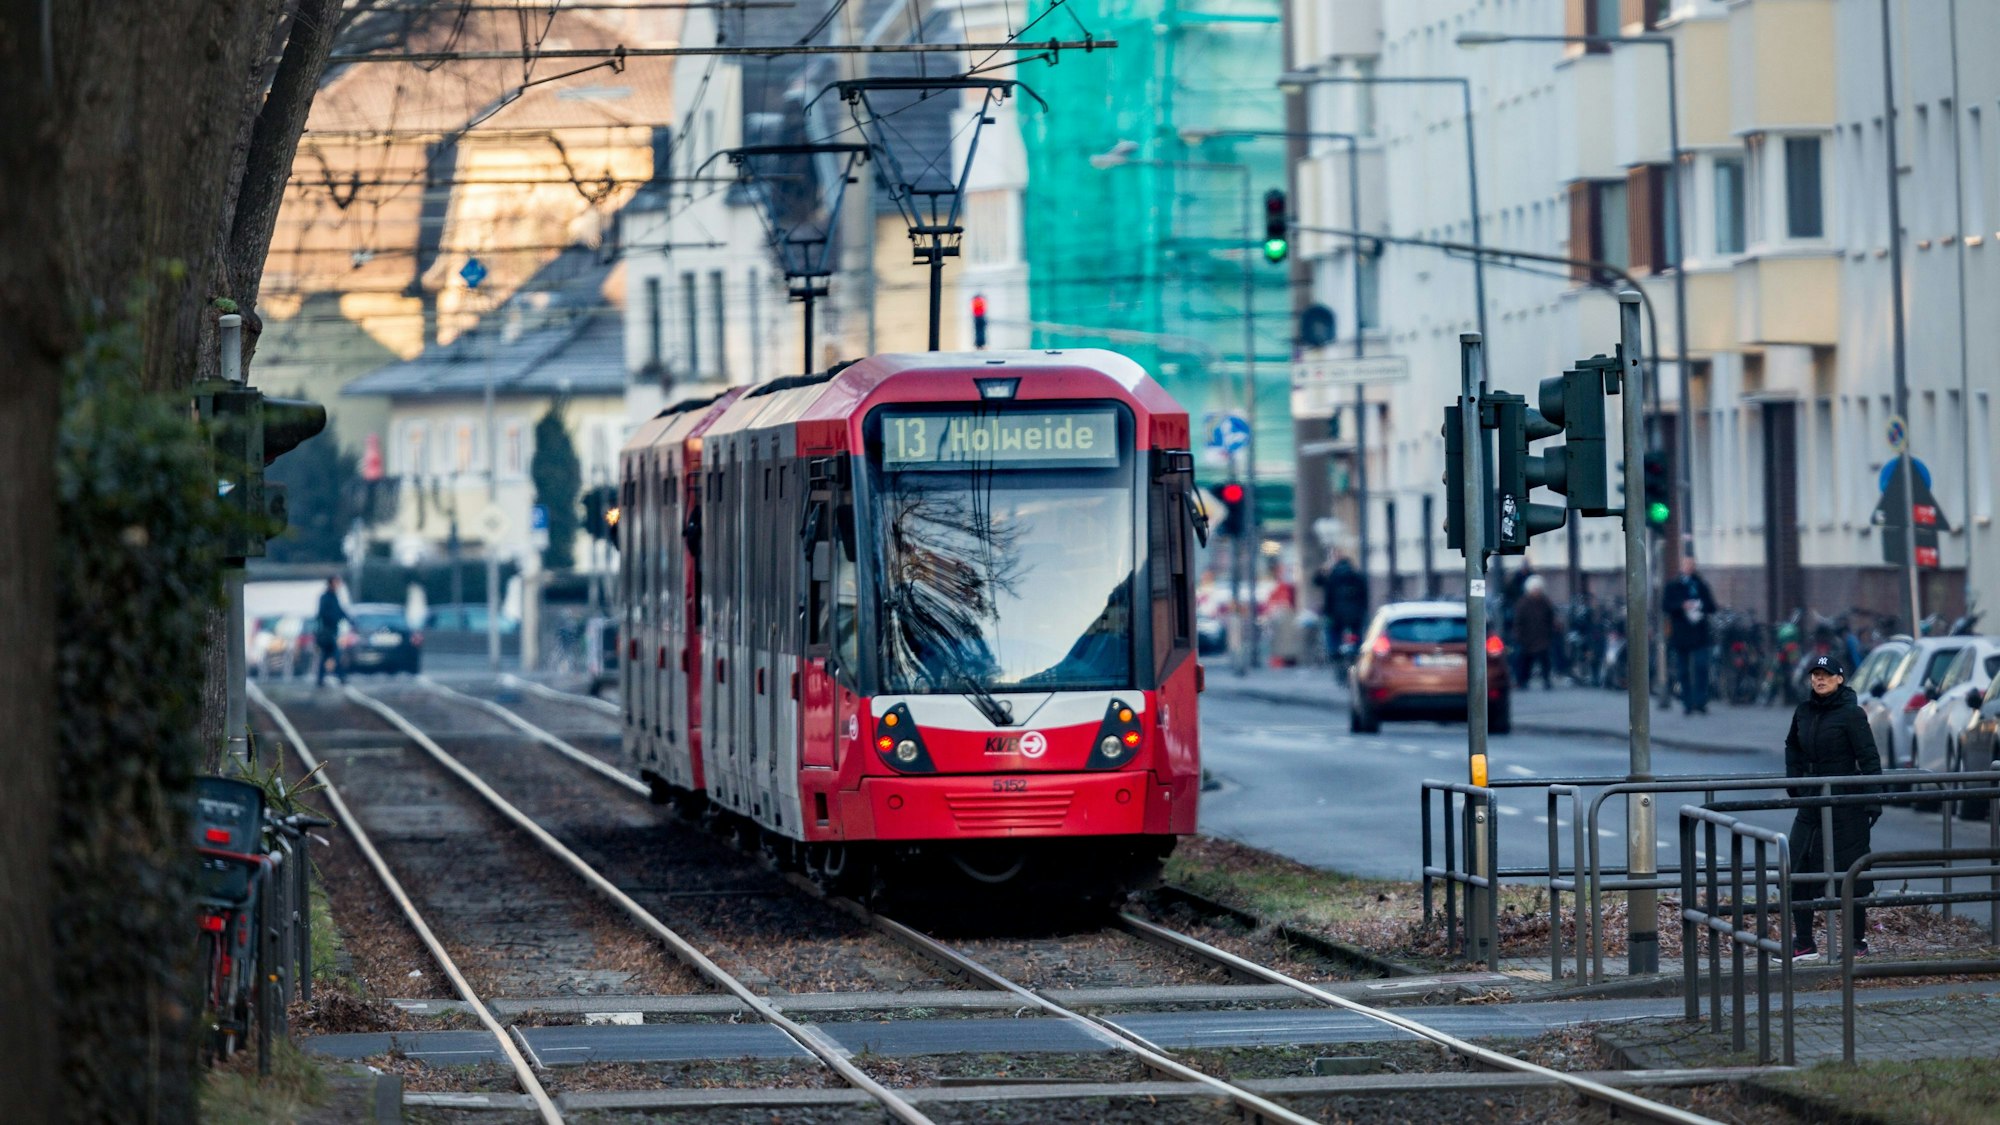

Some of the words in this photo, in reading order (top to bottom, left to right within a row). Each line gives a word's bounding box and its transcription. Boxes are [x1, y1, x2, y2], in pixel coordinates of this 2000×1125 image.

[895, 418, 927, 458] 13
[951, 417, 1094, 452] Holweide
[985, 736, 1020, 752] KVB
[992, 779, 1028, 793] 5152
